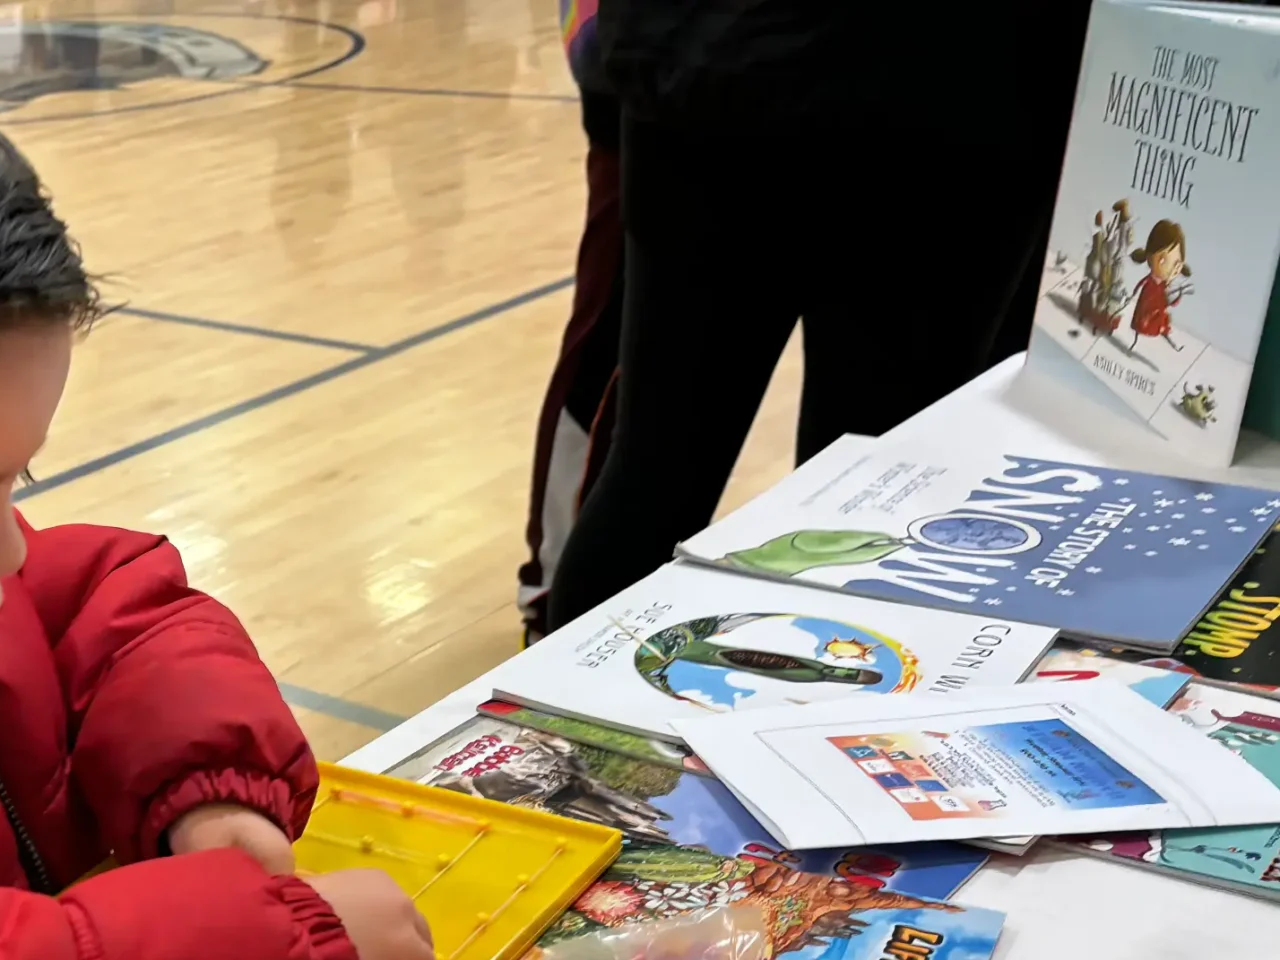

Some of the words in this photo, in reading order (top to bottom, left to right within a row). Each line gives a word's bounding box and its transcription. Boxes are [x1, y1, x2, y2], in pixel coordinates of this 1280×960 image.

[1152, 45, 1178, 80] THE
[1180, 51, 1219, 91] MOST
[1103, 71, 1259, 163] MAGNIFICENT
[878, 466, 1103, 603] SNOW
[1082, 502, 1137, 529] THE
[1043, 527, 1110, 570] STORY
[1024, 567, 1068, 588] OF
[635, 601, 673, 624] SUE
[951, 624, 1011, 669] CORN
